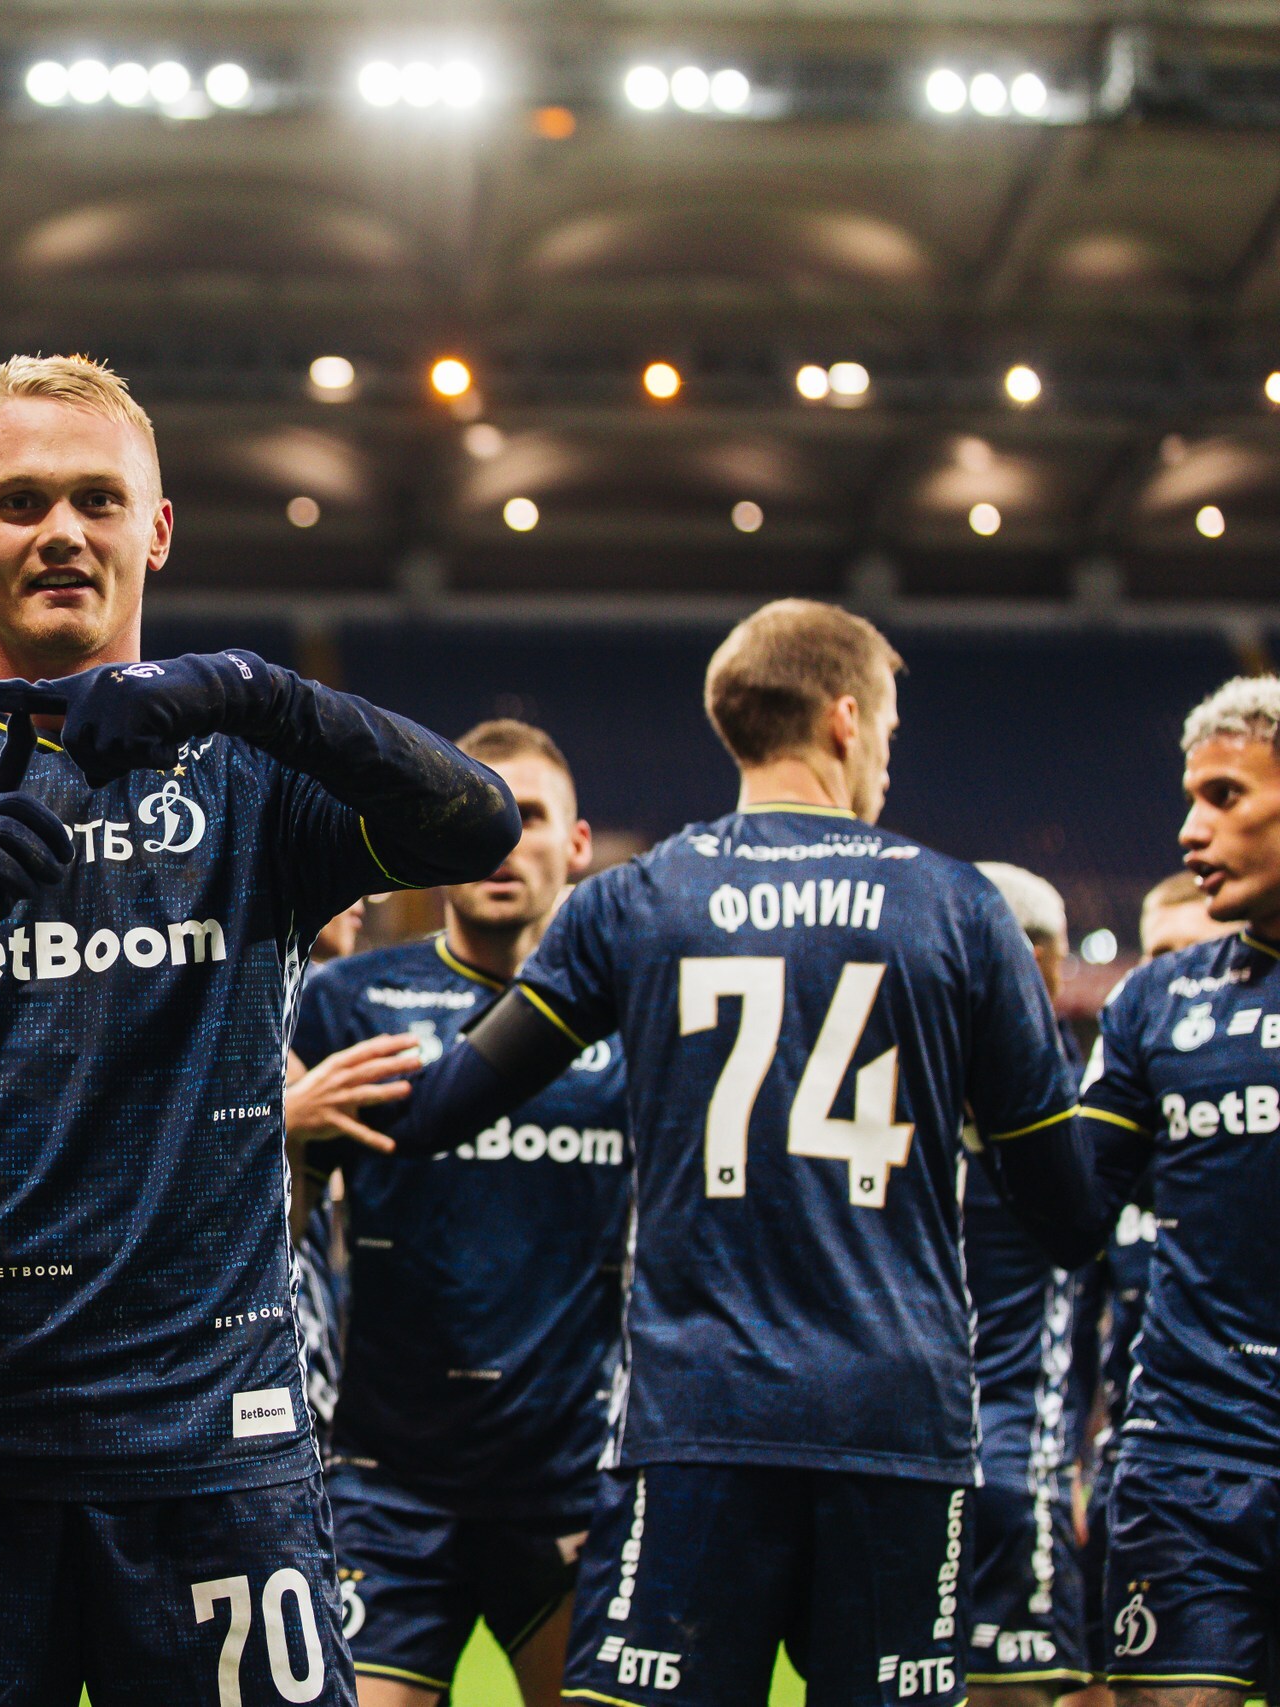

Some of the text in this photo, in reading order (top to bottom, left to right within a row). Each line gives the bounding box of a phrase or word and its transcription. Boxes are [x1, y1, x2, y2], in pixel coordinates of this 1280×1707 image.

[63, 818, 133, 863] ТБ
[709, 878, 886, 934] ФОМИН
[679, 956, 916, 1209] 74
[213, 1105, 271, 1121] BETBOOM
[240, 1407, 286, 1420] BetBoom
[933, 1488, 965, 1640] BetBoom
[191, 1567, 325, 1707] 70
[997, 1630, 1057, 1663] ВТБ
[618, 1646, 682, 1690] ВТБ
[898, 1656, 956, 1698] ВТБ
